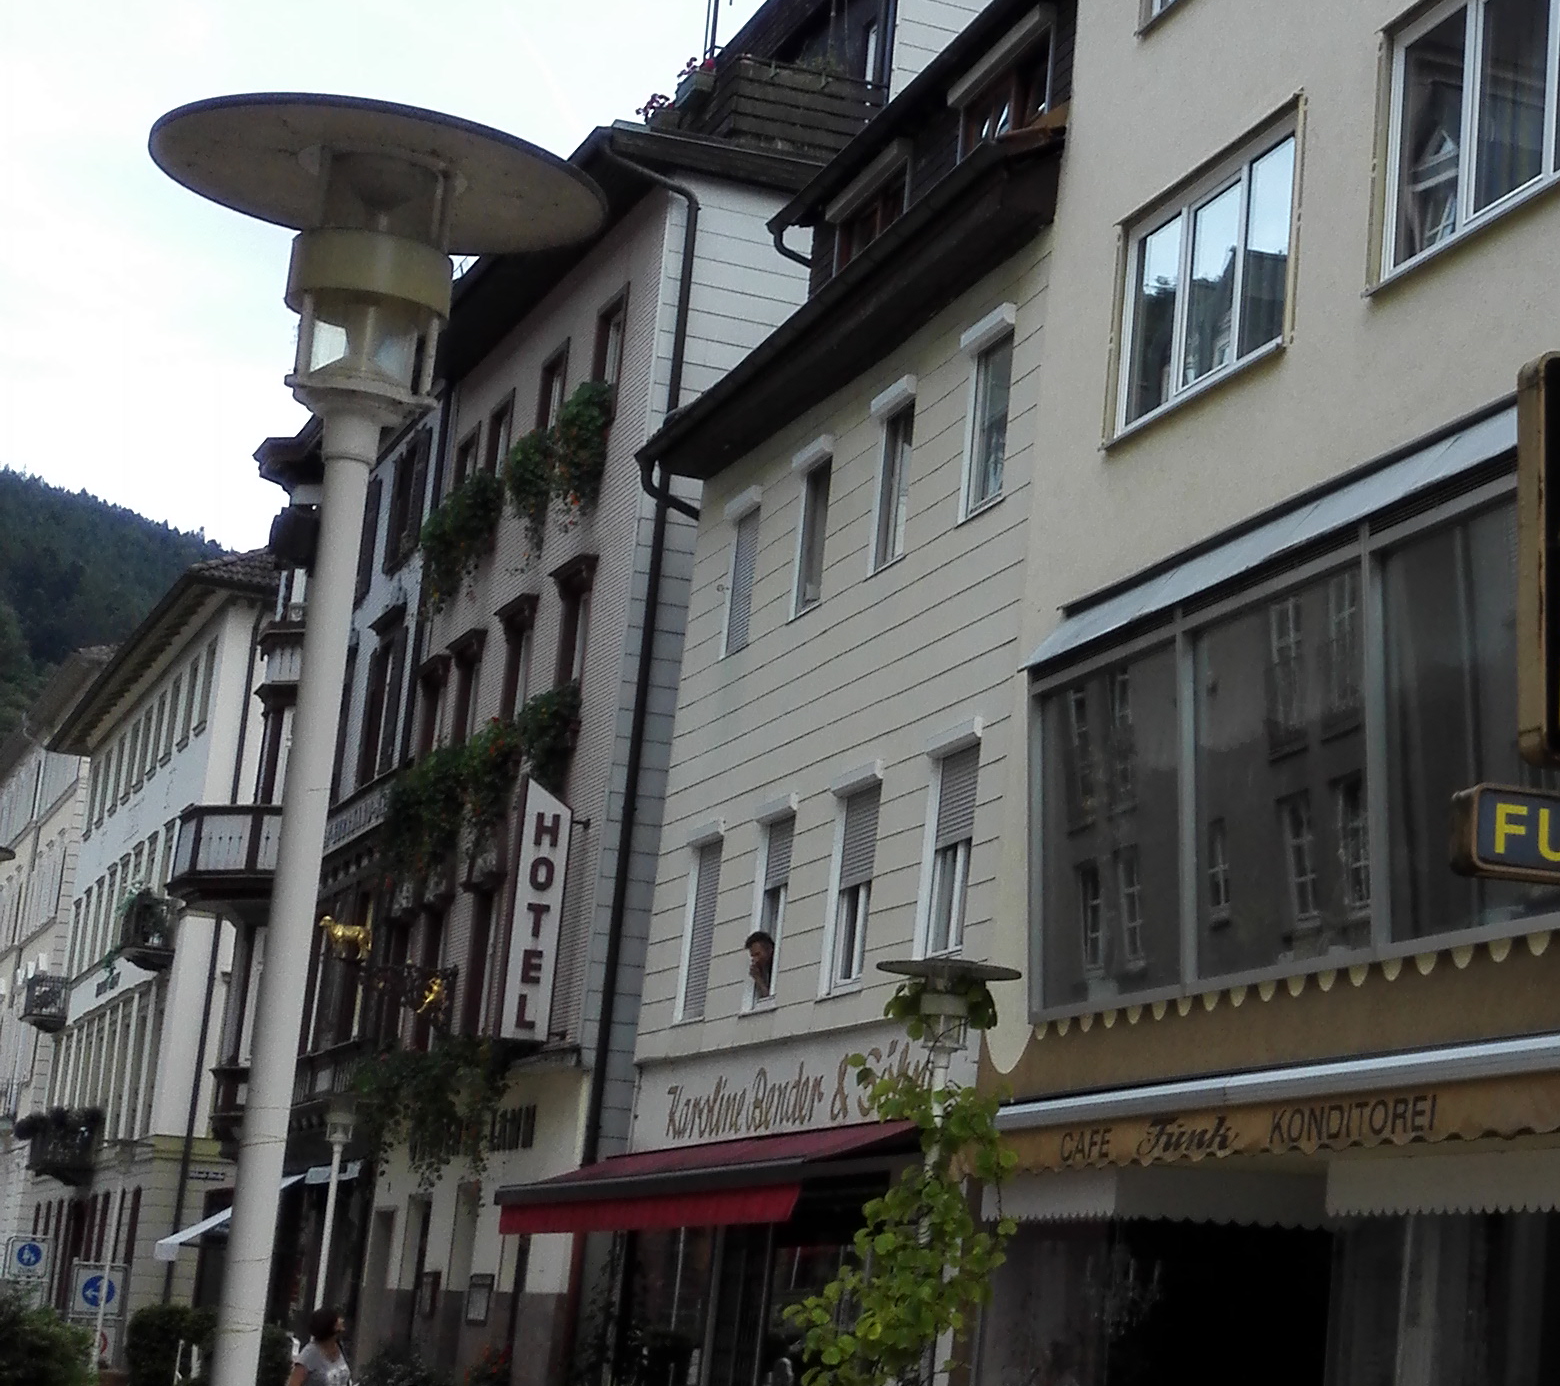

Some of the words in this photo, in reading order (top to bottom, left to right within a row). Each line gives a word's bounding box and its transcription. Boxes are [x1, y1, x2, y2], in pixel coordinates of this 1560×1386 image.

[514, 811, 562, 1031] HOTEL
[666, 1075, 746, 1140] Karoline
[747, 1059, 825, 1132] Bender
[830, 1053, 850, 1121] &
[1060, 1125, 1112, 1163] CAFE
[1267, 1093, 1440, 1146] KONDITOREI
